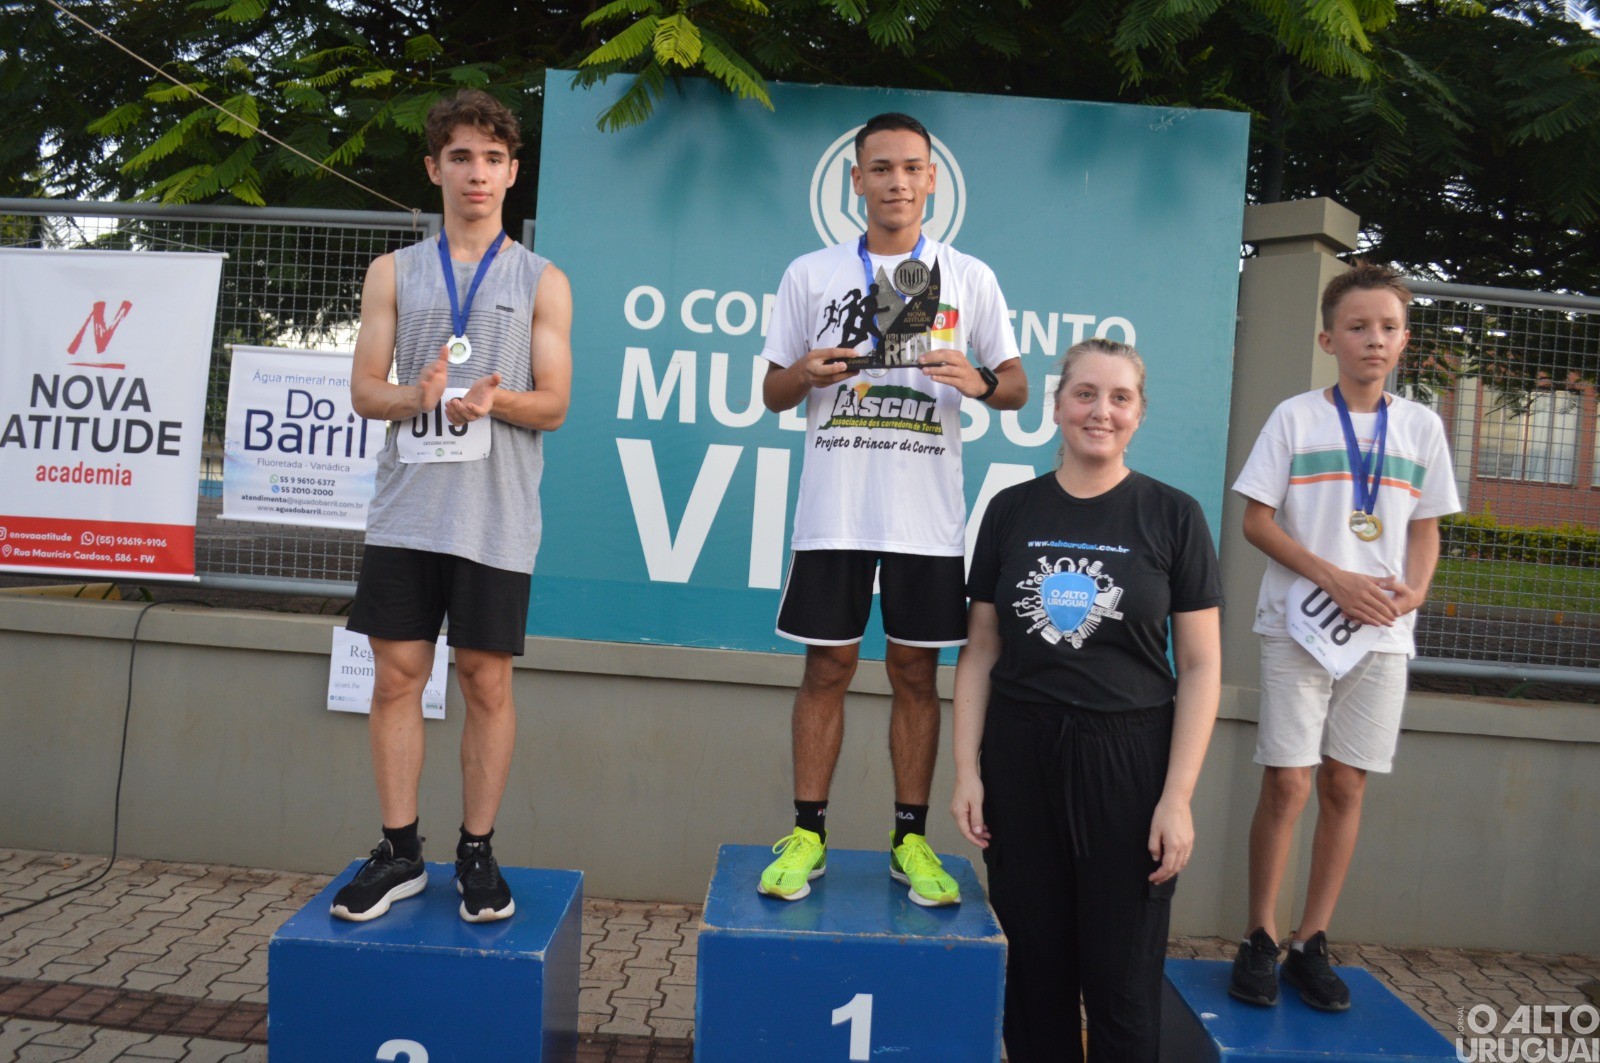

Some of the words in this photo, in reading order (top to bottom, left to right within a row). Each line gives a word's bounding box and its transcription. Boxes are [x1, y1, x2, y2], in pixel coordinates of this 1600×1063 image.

[624, 285, 665, 330] O
[253, 368, 282, 384] Água
[285, 373, 326, 385] mineral
[29, 373, 152, 413] NOVA
[286, 388, 336, 421] Do
[868, 418, 880, 427] dos
[0, 414, 183, 457] ATITUDE
[244, 408, 368, 459] Barril
[815, 436, 850, 452] Projeto
[853, 436, 898, 450] Brincar
[900, 438, 911, 451] de
[912, 440, 946, 456] Correr
[35, 461, 133, 487] academia
[257, 458, 303, 470] Fluoretada
[310, 461, 350, 473] Vanádica
[290, 476, 296, 484] 9
[297, 477, 336, 487] 9610-6372
[281, 486, 290, 494] 55
[292, 486, 334, 497] 2010-2000
[96, 534, 115, 547] (55)
[116, 536, 168, 548] 93619-9106
[13, 547, 31, 557] Rua
[73, 551, 114, 563] Cardoso,
[115, 554, 132, 563] 586
[140, 555, 156, 564] FW
[1047, 598, 1088, 608] URUGUAI
[1051, 589, 1060, 598] O
[1061, 590, 1088, 600] ALTO
[833, 993, 877, 1060] 1
